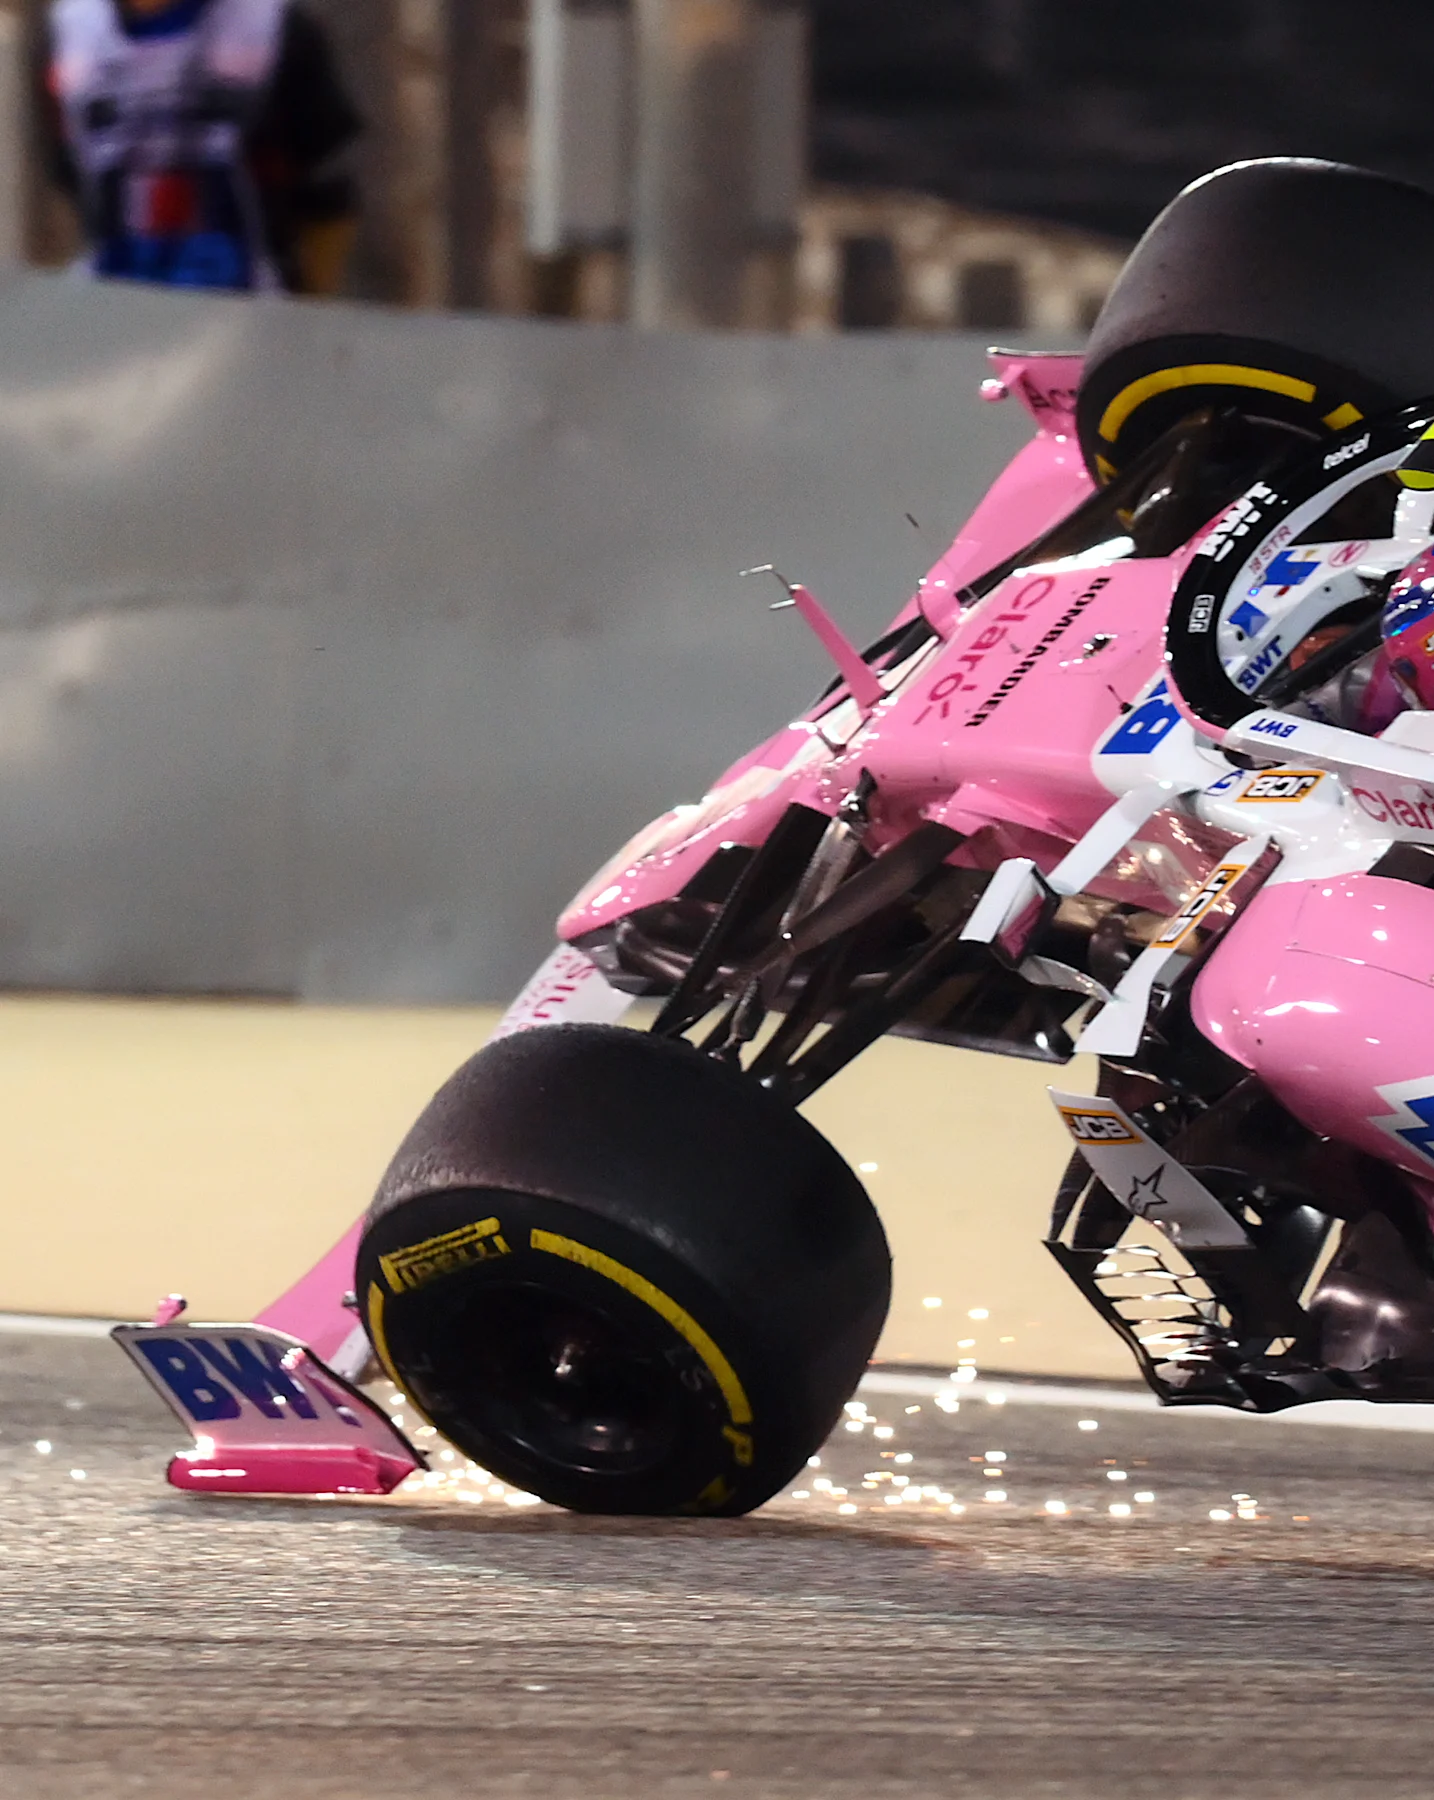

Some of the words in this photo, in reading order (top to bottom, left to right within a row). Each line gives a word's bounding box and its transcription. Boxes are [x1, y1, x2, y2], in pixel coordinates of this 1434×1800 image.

[1261, 524, 1292, 560] STR
[963, 576, 1113, 728] BOMBARDIER
[1236, 635, 1284, 696] BWT
[1249, 717, 1298, 739] BWT
[1248, 773, 1318, 799] JCB
[1070, 1115, 1132, 1139] JCB
